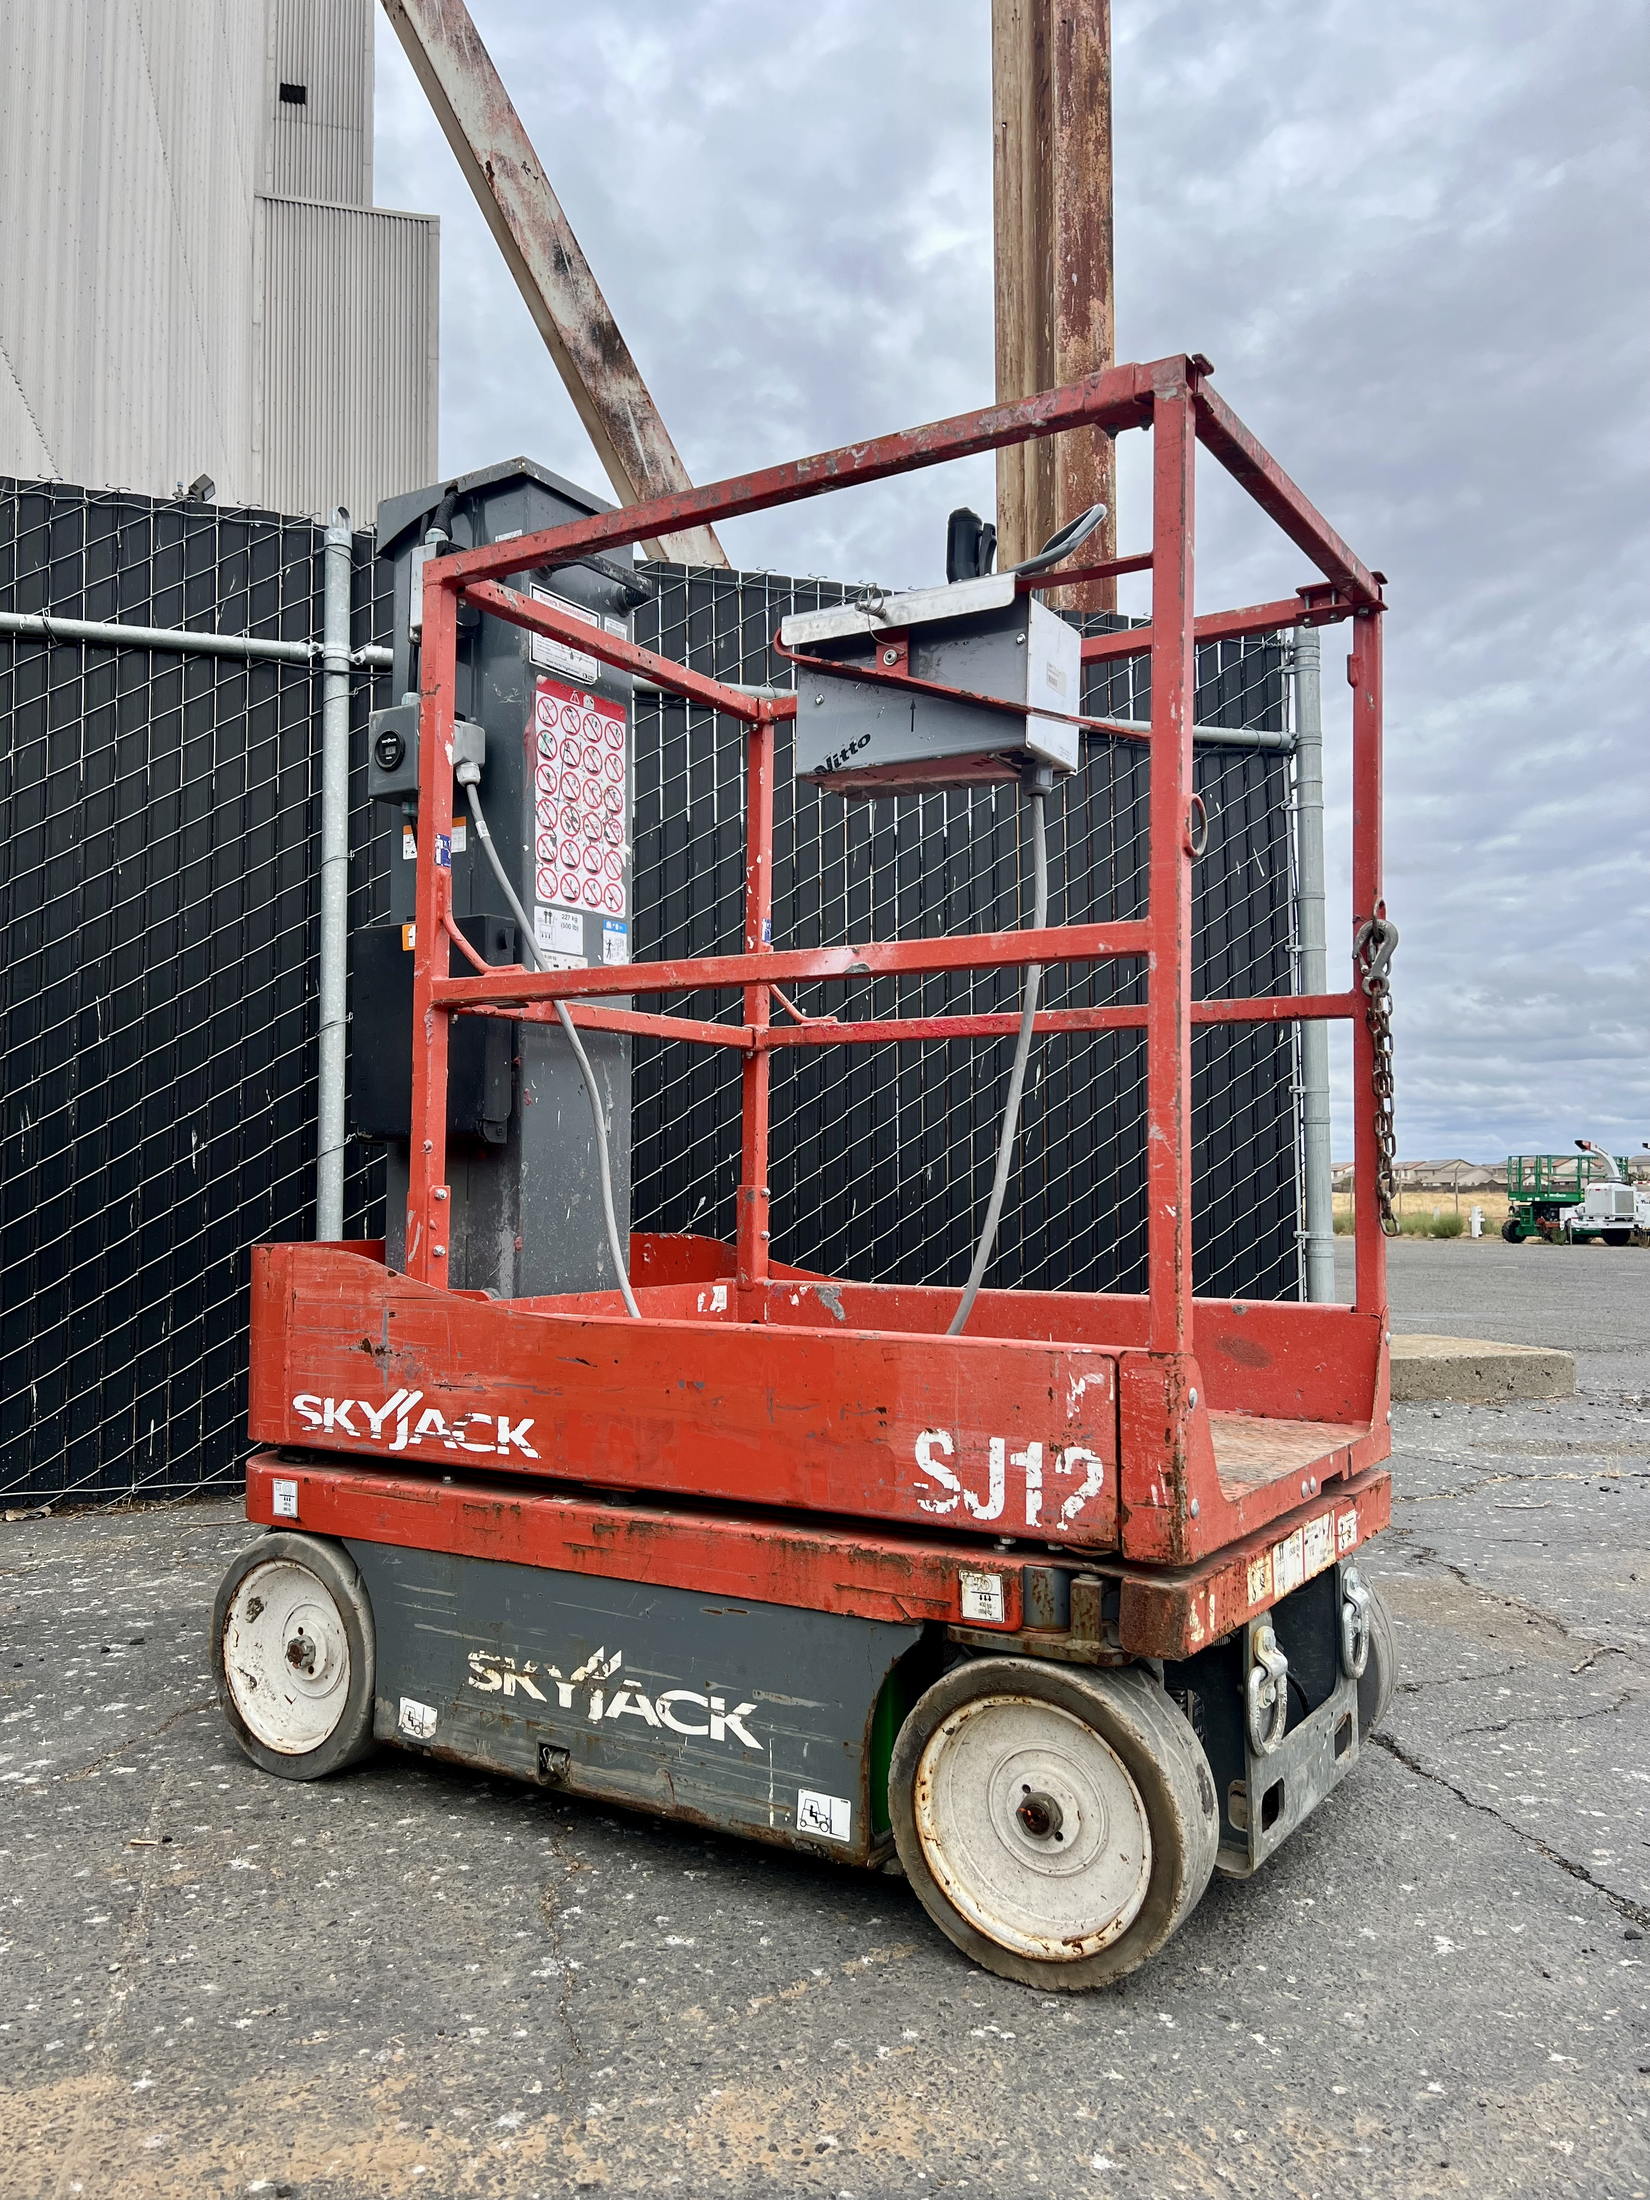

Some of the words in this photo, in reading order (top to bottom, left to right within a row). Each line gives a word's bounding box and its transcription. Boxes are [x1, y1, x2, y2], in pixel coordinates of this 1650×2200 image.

[292, 1388, 542, 1459] SKYJACK
[914, 1428, 1104, 1531] SJ12
[467, 1646, 765, 1750] SKYJACK
